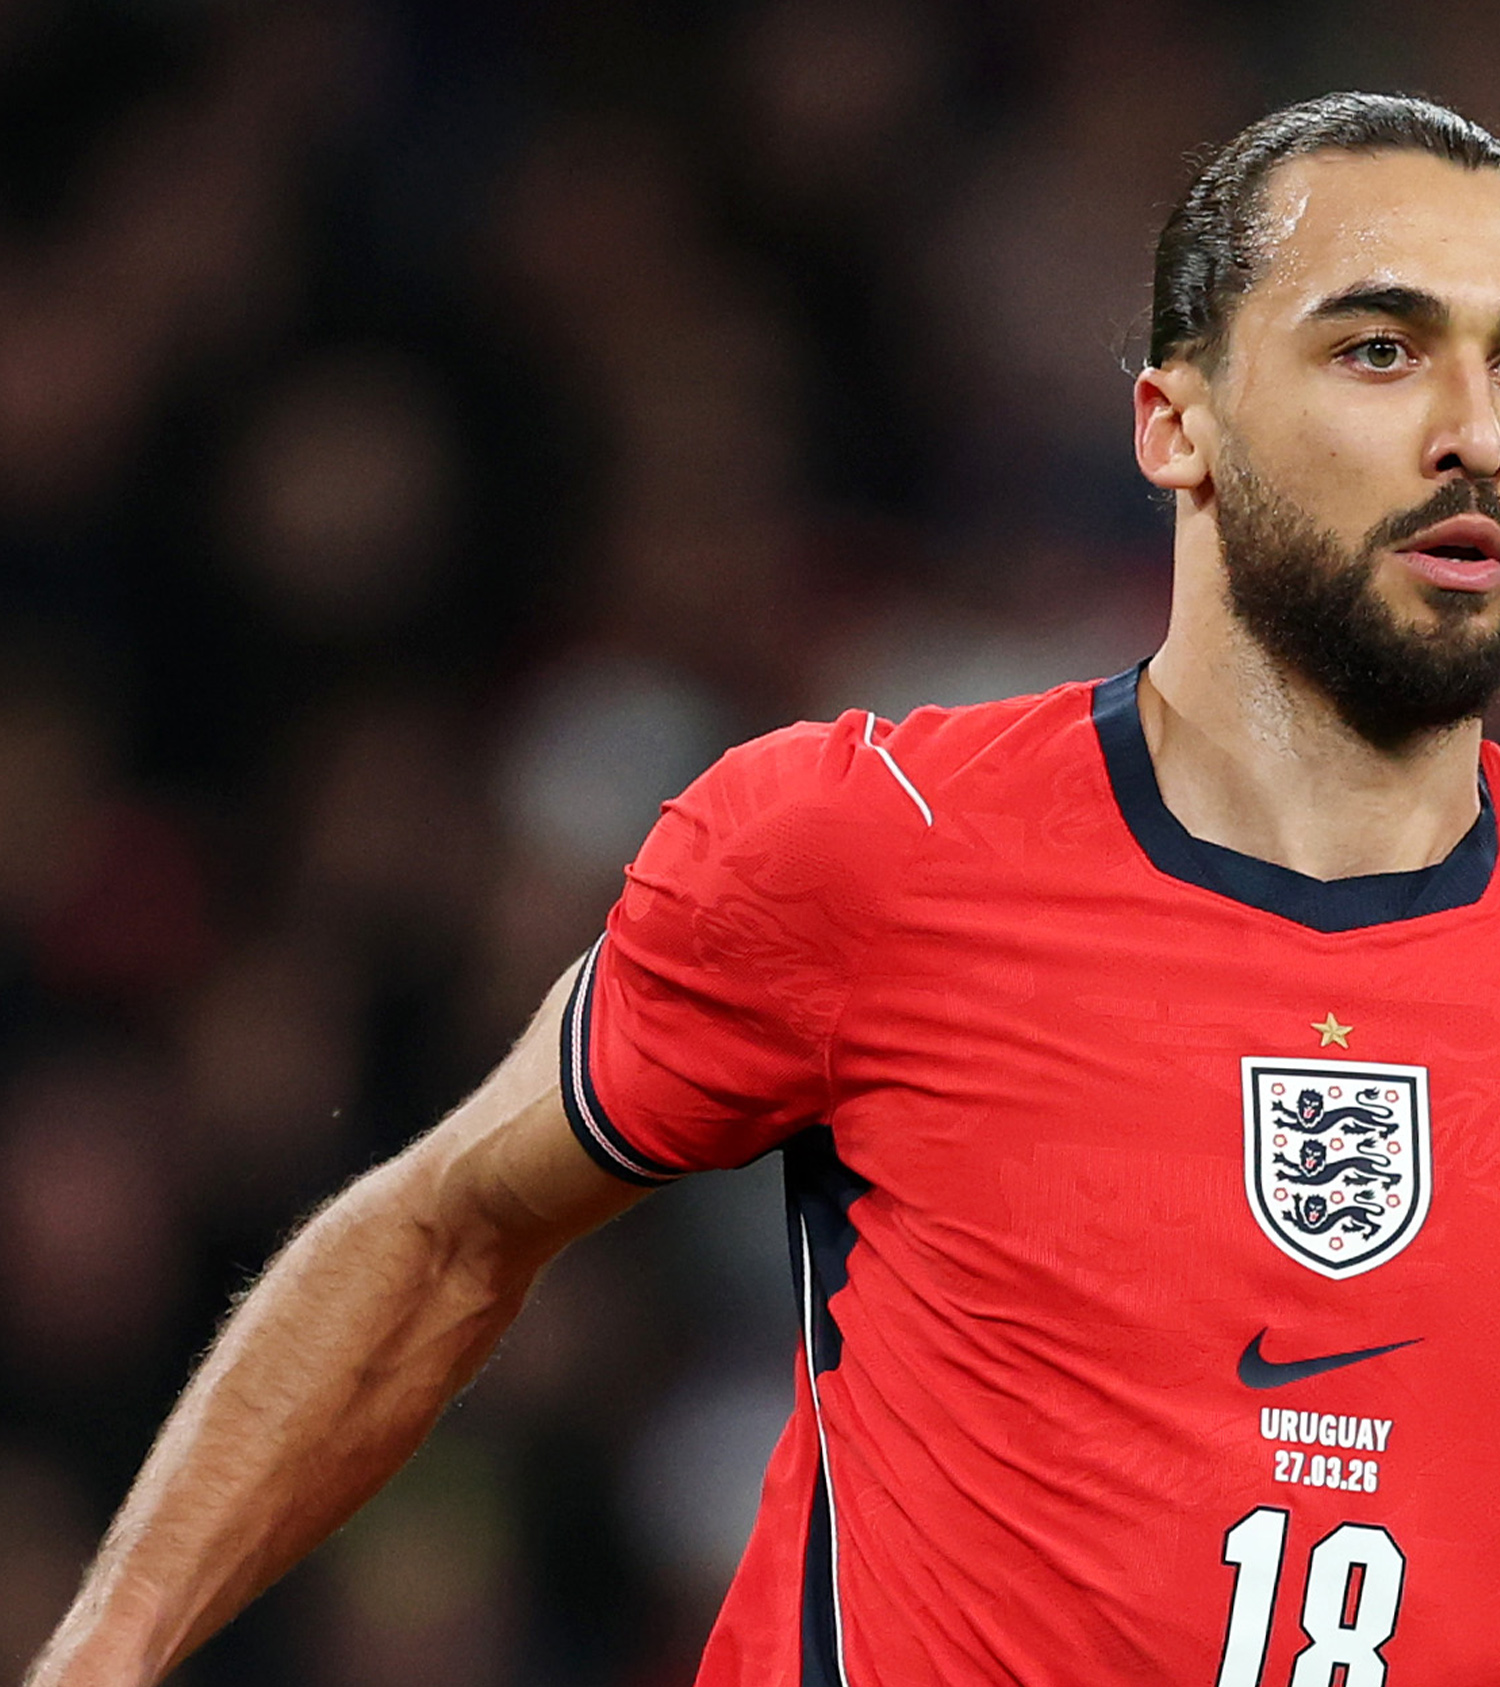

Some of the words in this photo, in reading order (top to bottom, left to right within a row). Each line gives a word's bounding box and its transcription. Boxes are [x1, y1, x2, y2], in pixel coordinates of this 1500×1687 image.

[1260, 1407, 1392, 1452] URUGUAY
[1274, 1449, 1378, 1493] 27.03.26
[1216, 1505, 1406, 1687] 18
